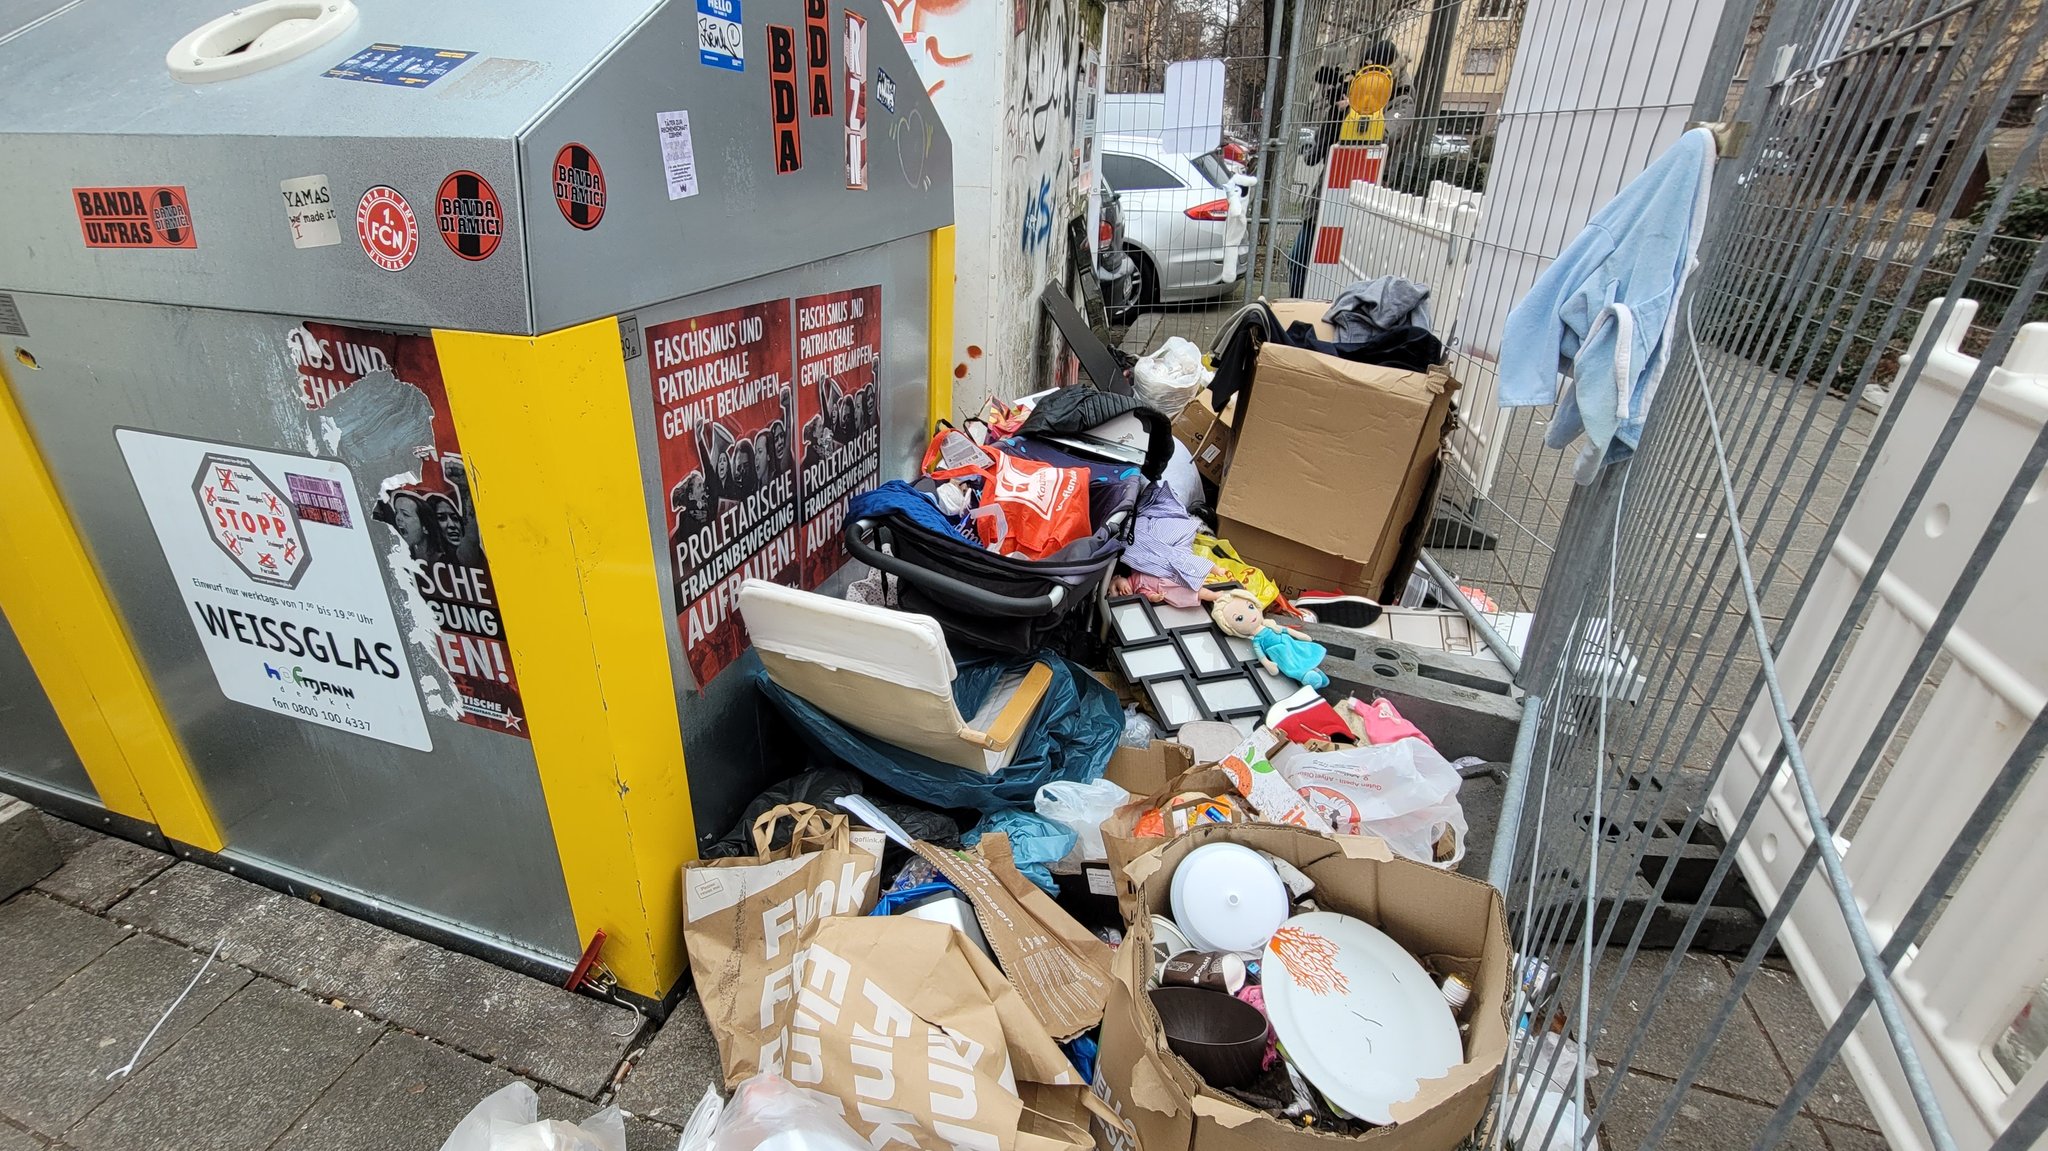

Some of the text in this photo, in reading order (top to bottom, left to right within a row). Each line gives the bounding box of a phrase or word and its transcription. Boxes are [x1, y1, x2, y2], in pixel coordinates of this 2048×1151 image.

[558, 165, 601, 191] BANDA
[78, 192, 148, 216] BANDA
[283, 186, 330, 208] YAMAS
[441, 198, 496, 218] BANDA
[85, 222, 154, 244] ULTRAS
[303, 210, 325, 224] made
[326, 208, 337, 220] it
[440, 216, 501, 236] DI AMICI
[371, 221, 403, 251] FCN
[369, 250, 405, 269] ULTRAS
[654, 316, 762, 369] FASCHISMUS UND
[800, 325, 855, 360] PATRIARCHALE
[659, 352, 749, 406] PATRIARCHALE
[801, 357, 832, 387] GEWALT
[662, 394, 713, 440] GEWALT
[717, 372, 779, 419] BEKÄMPFEN
[803, 425, 878, 498] PROLETARISCHE
[804, 453, 878, 522] FRAUENBEWEGUNG
[215, 506, 287, 538] STOPP
[676, 469, 793, 578] PROLETARISCHE
[681, 503, 795, 607] FRAUENBEWEGUNG
[192, 577, 223, 593] Einwurf
[225, 587, 240, 596] nur
[240, 590, 279, 606] werktags
[280, 599, 297, 609] von
[316, 605, 332, 616] bis
[356, 613, 374, 625] Uhr
[194, 601, 400, 680] WEISSGLAS
[272, 697, 371, 731] fon 0800 100 4337
[976, 886, 1015, 931] essen.
